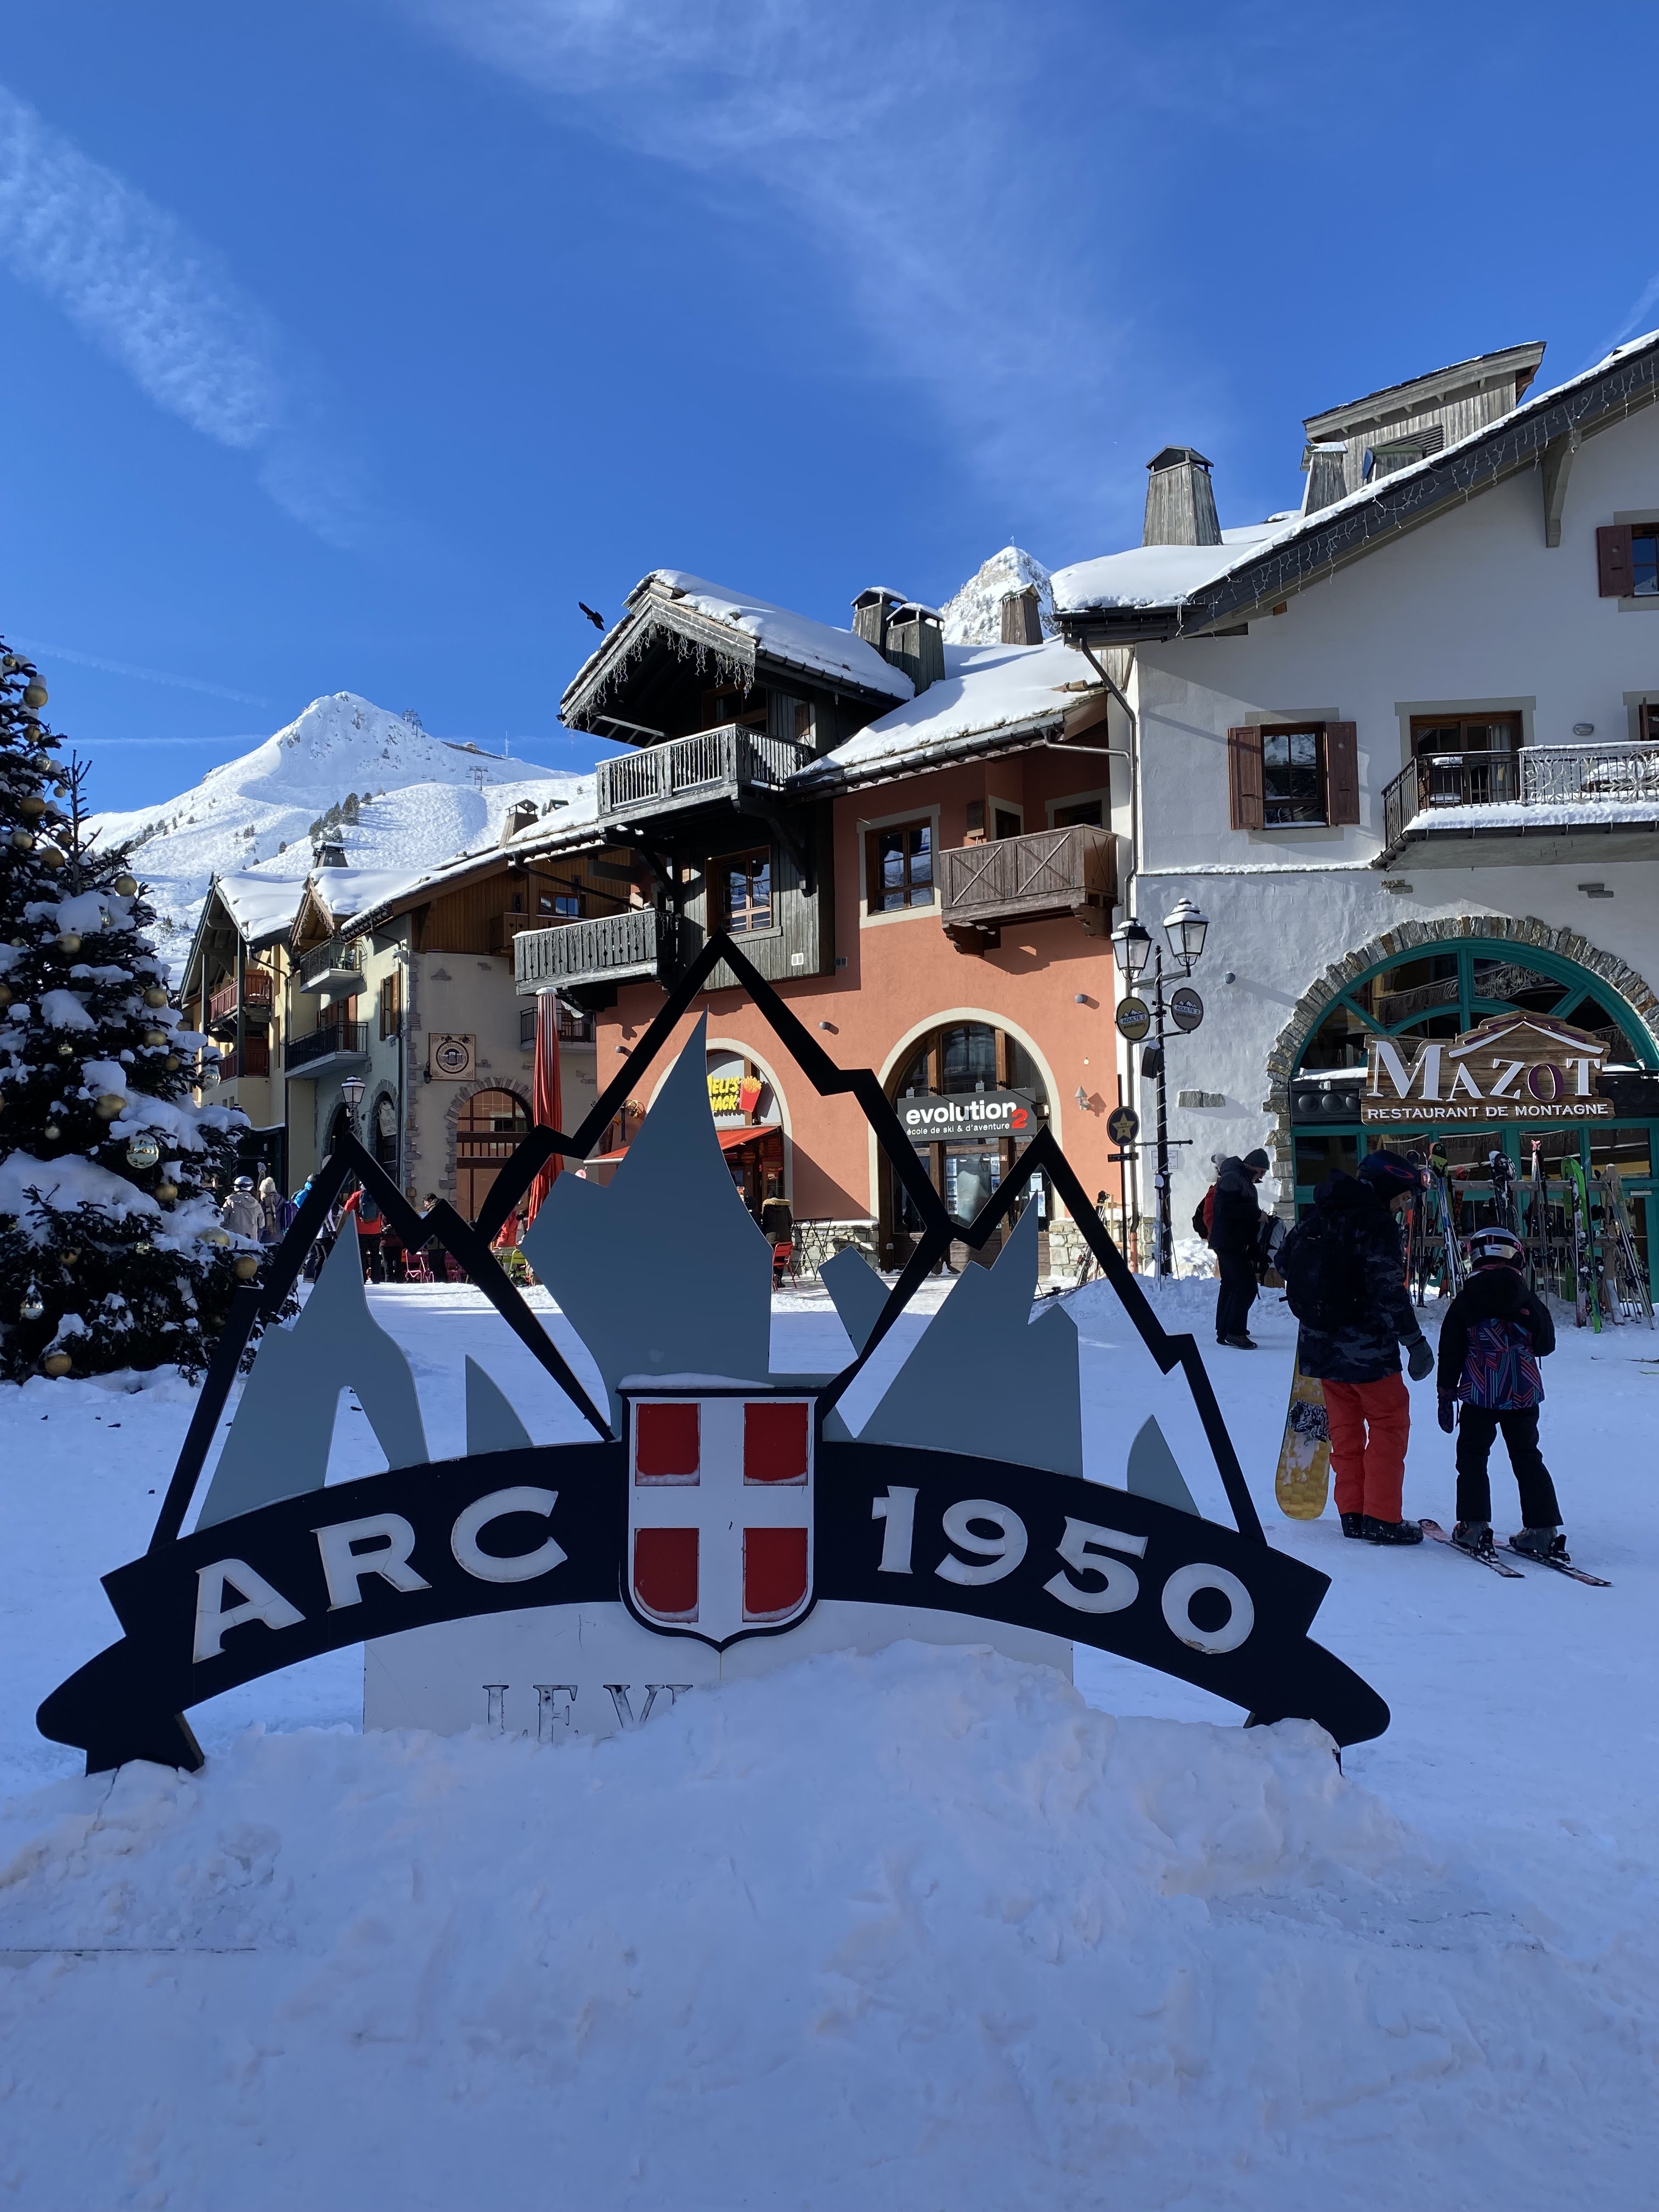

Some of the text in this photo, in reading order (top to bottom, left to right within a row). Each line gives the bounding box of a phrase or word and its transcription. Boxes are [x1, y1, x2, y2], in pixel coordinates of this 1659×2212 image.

[1176, 1006, 1194, 1014] ADULTE
[709, 1094, 738, 1111] NACK
[1368, 1104, 1608, 1119] RESTAURANT DE MONTAGNE
[943, 1125, 954, 1133] ski
[966, 1122, 1010, 1132] d'aventure
[192, 1486, 1255, 1664] ARC 1950
